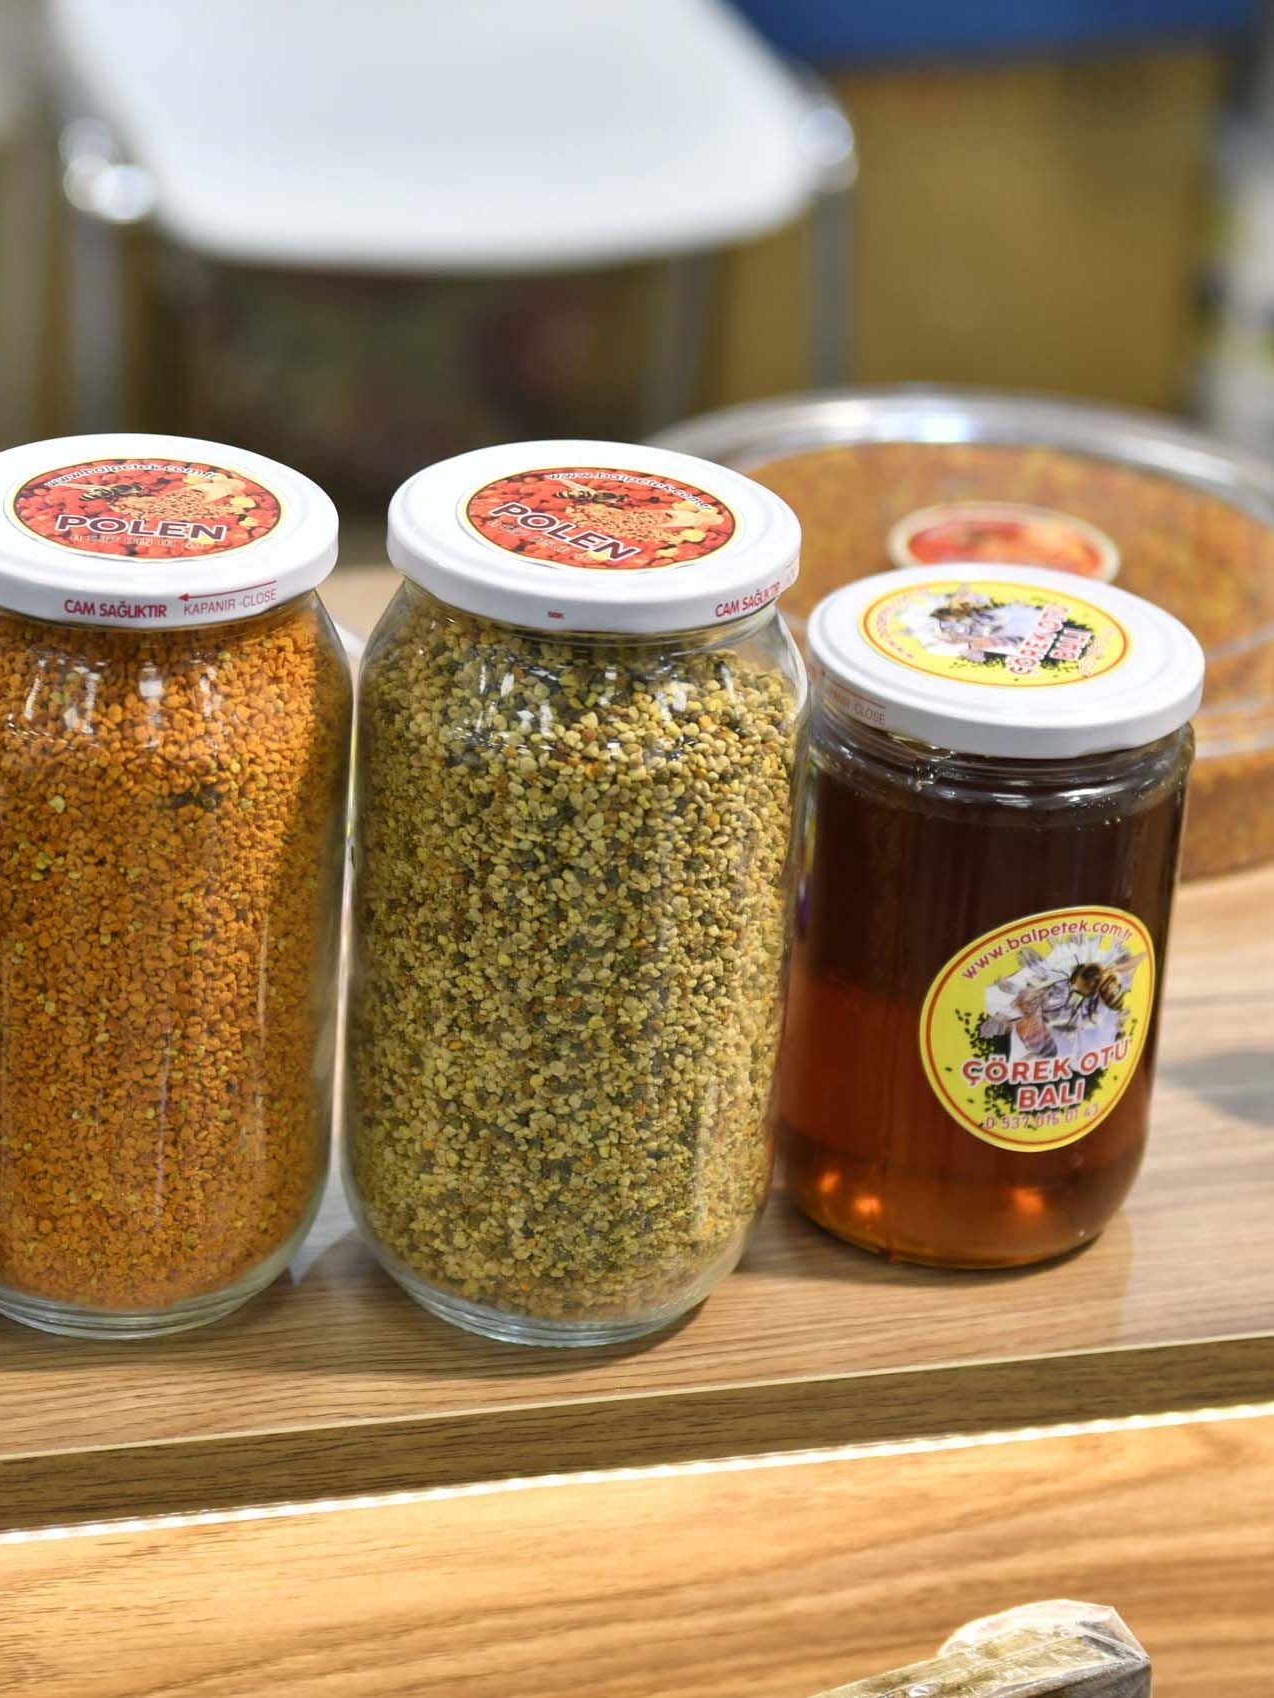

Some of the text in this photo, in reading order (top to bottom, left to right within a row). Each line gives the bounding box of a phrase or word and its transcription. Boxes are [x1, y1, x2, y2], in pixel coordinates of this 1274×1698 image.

[57, 515, 227, 540] POLEN
[491, 502, 642, 561] POLEN
[64, 600, 167, 618] CAM SAĞLIKTIR
[183, 599, 236, 616] KAPANIR
[715, 600, 740, 617] CAM
[962, 919, 1133, 981] www.balpetek.com.tr
[962, 1039, 1130, 1086] ÇÖREK OTU
[1018, 1081, 1085, 1110] BALI
